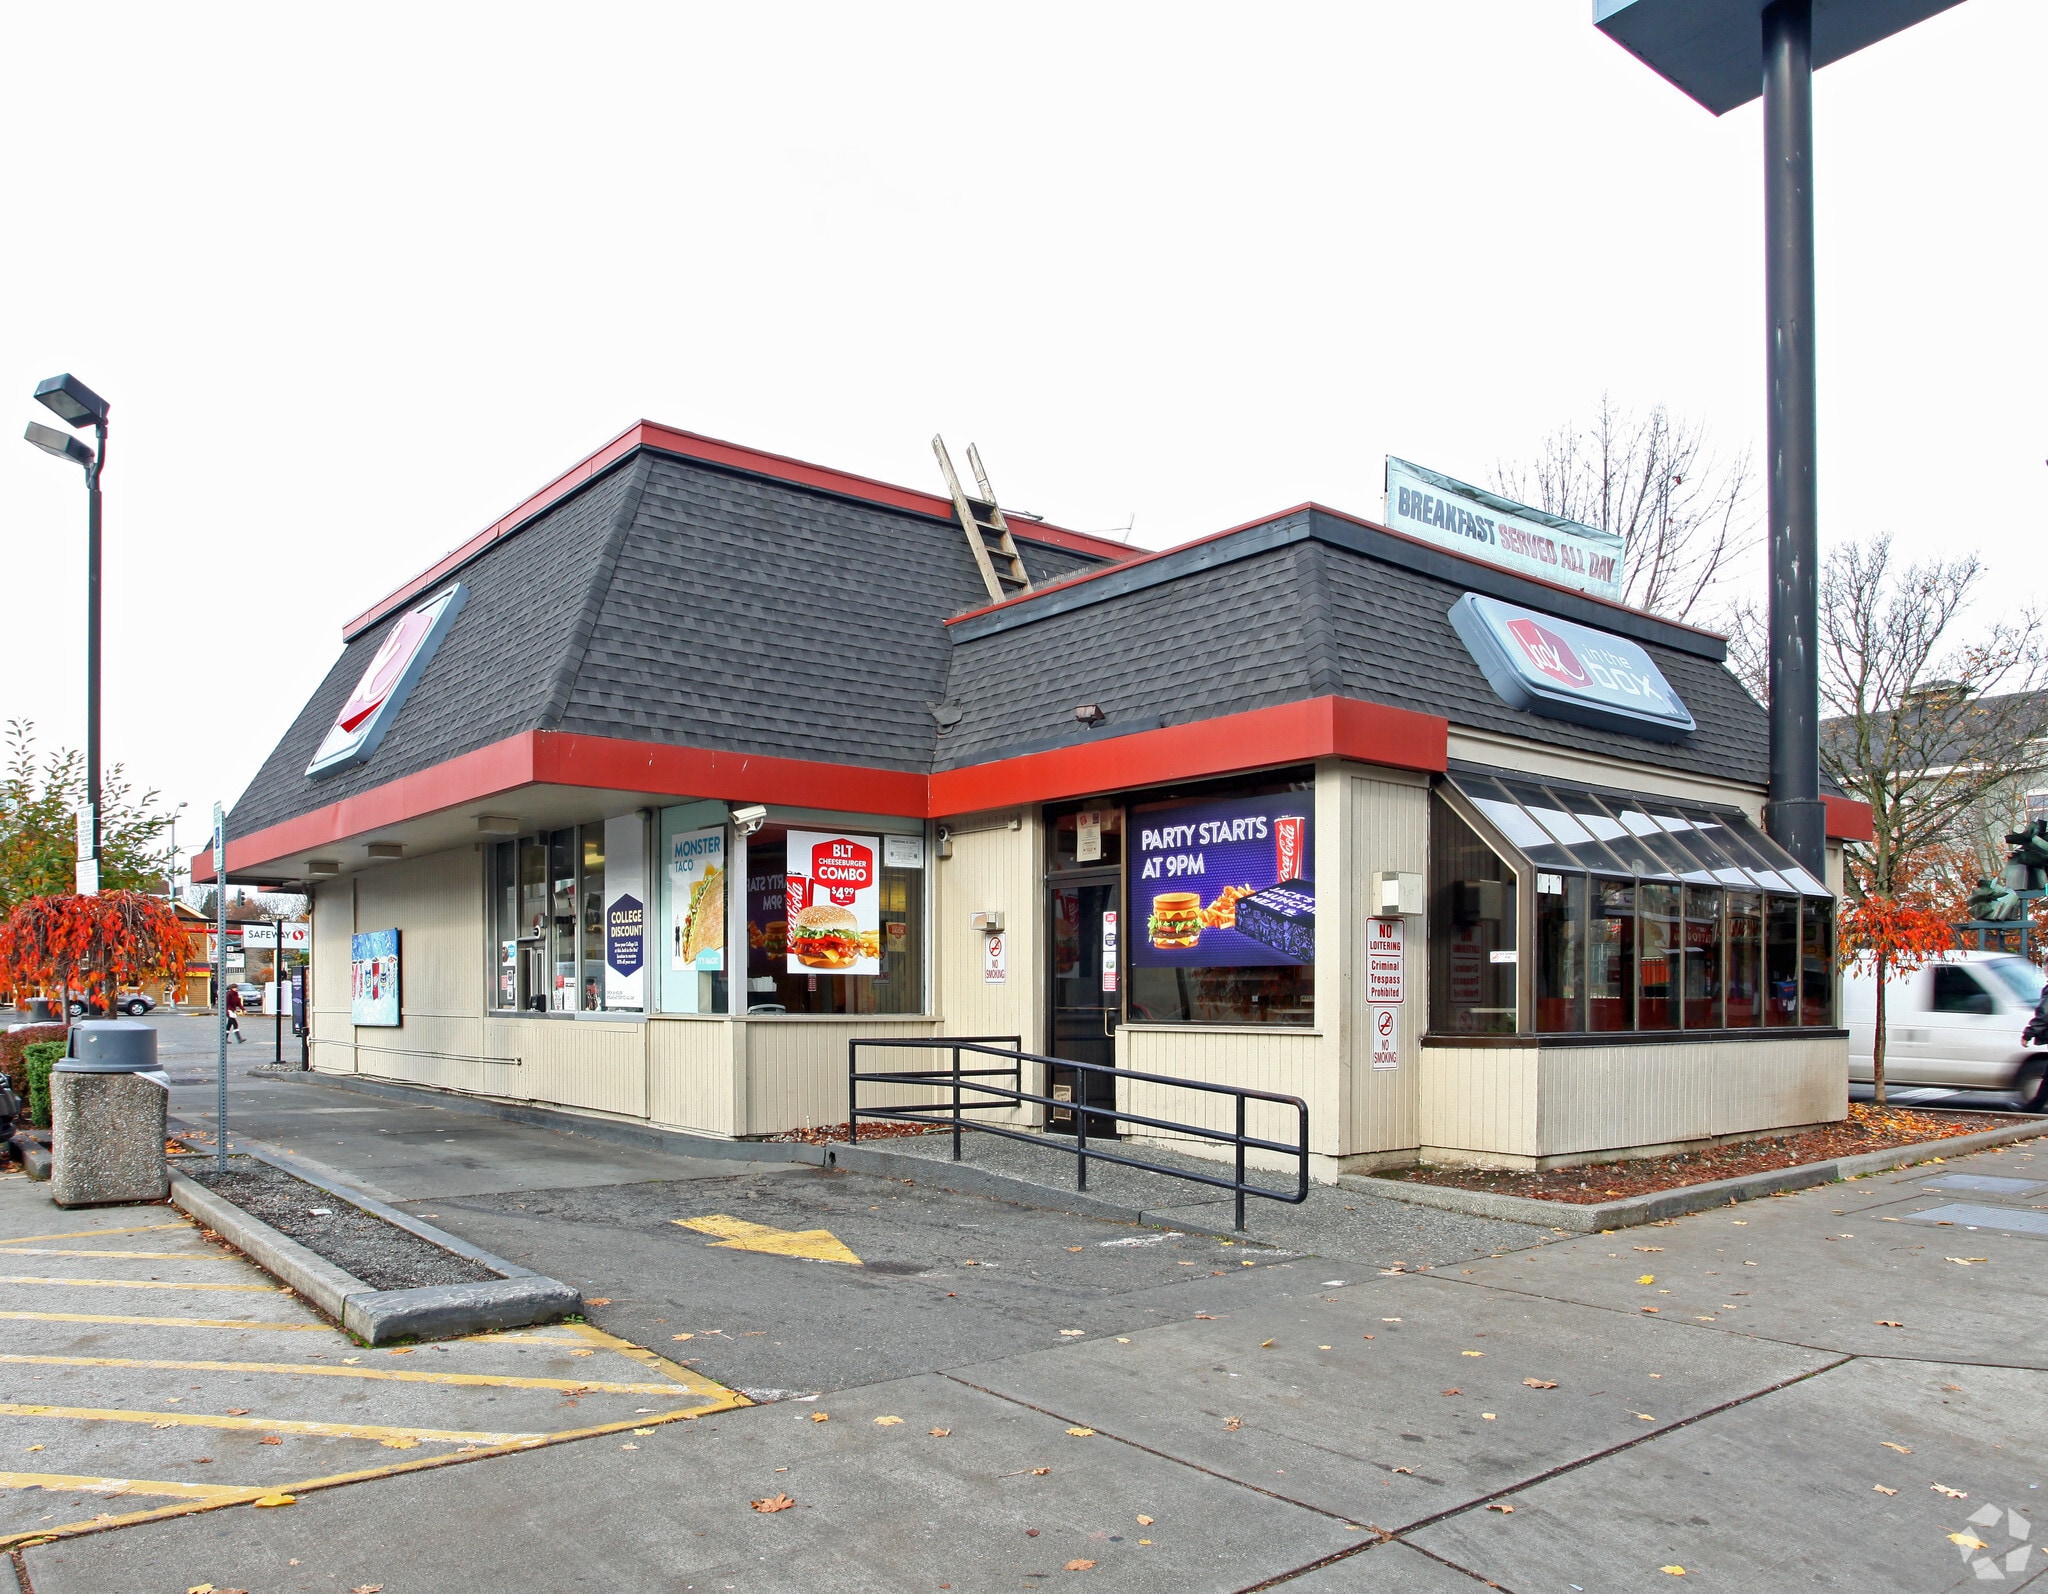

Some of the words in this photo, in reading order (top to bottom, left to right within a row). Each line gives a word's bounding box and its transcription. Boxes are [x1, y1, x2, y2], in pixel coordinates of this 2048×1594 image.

[1398, 486, 1495, 546] BREAKFAST
[1497, 524, 1558, 566] SERVED
[1560, 543, 1586, 575] ALL
[1588, 552, 1616, 584] DAY
[1582, 643, 1600, 664] in
[1604, 652, 1632, 671] the
[1580, 653, 1663, 701] box
[1141, 824, 1197, 851] PARTY
[1198, 816, 1268, 846] STARTS
[675, 836, 720, 858] MONSTER
[832, 843, 854, 858] BLT
[674, 858, 694, 873] TACO
[818, 857, 867, 868] CHEESEBURGER
[1141, 857, 1164, 879] AT
[1165, 853, 1206, 877] 9PM
[818, 866, 867, 882] COMBO
[1246, 895, 1283, 911] MEAL
[1258, 890, 1316, 915] MUNCHI
[1268, 887, 1316, 904] JACK'S
[611, 909, 642, 925] COLLEGE
[248, 930, 291, 939] SAFEWAY
[611, 924, 643, 938] DISCOUNT
[1379, 924, 1392, 939] NO
[1369, 940, 1401, 951] LOITERING
[991, 959, 999, 969] NO
[1371, 959, 1399, 971] Criminal
[985, 969, 1005, 979] SMOKING
[1370, 973, 1401, 985] Trespass
[1370, 986, 1400, 998] Prohibited
[1381, 1039, 1390, 1051] NO
[1373, 1051, 1397, 1064] SMOKING
